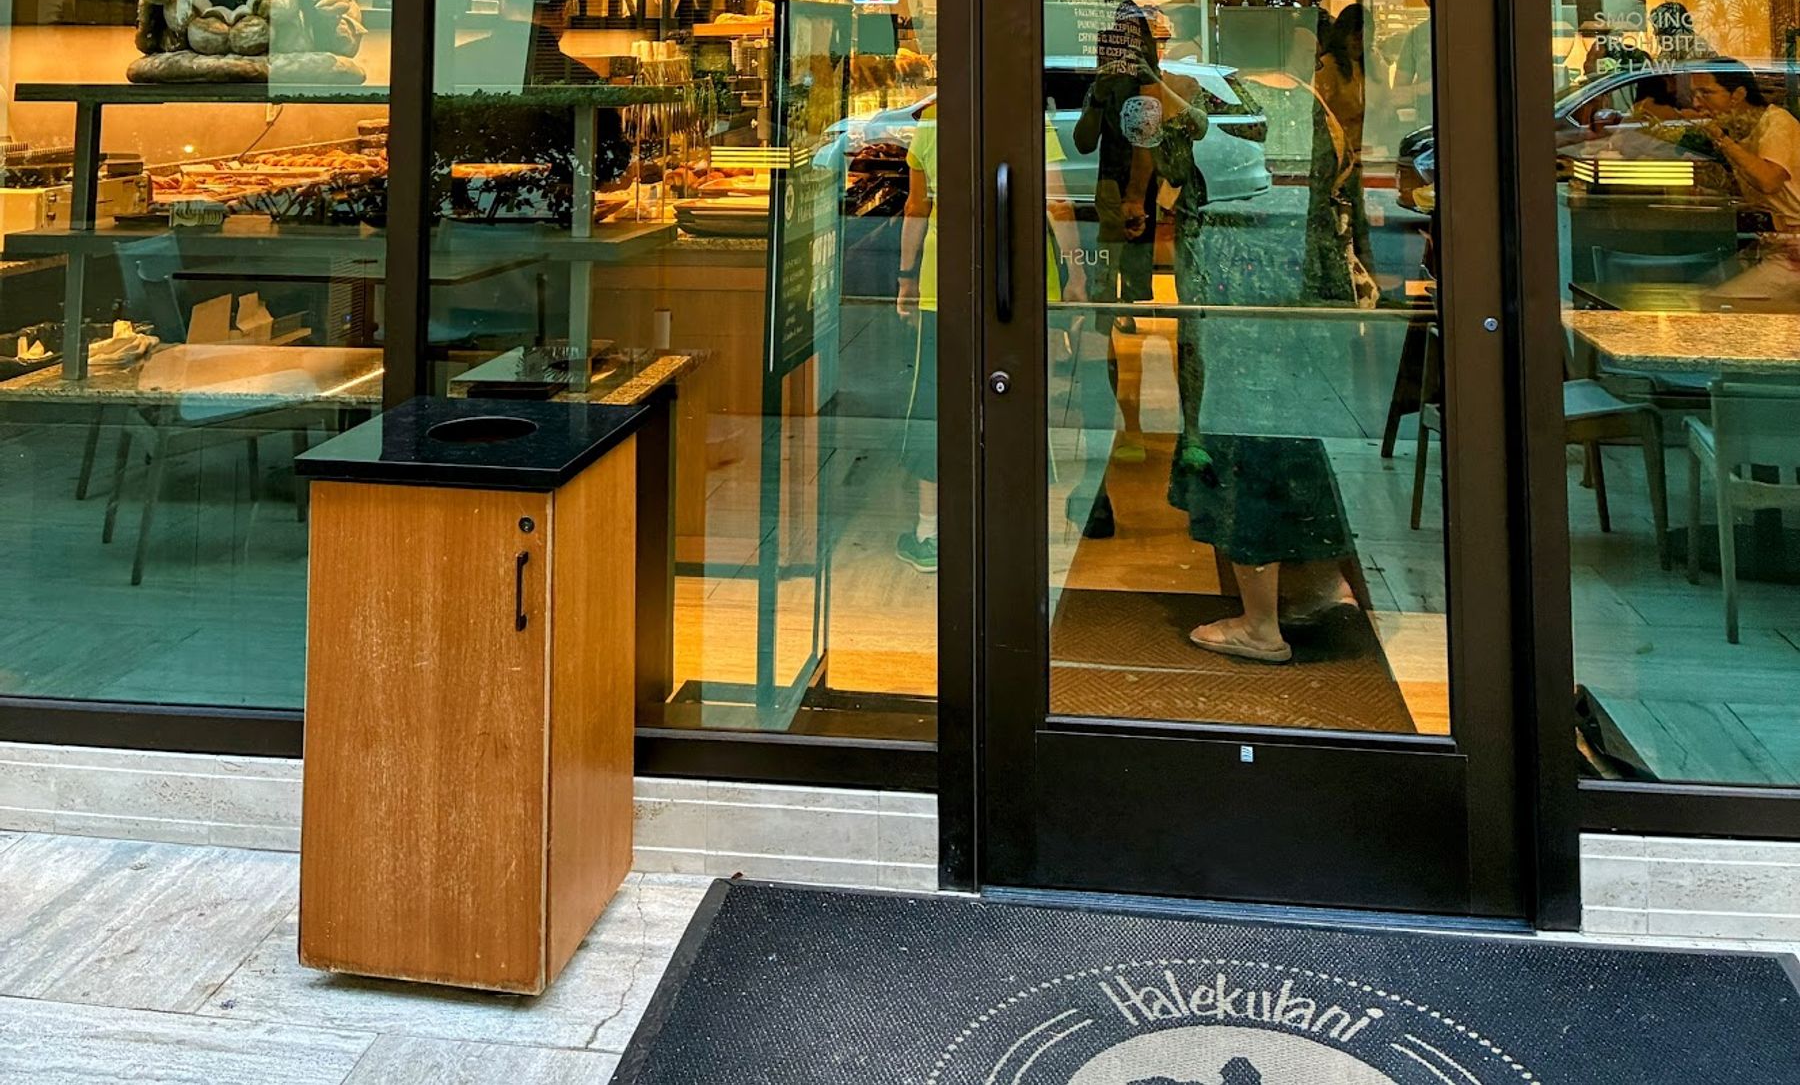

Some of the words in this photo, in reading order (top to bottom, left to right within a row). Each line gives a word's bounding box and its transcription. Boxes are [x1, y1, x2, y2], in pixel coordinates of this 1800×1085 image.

[1594, 11, 1695, 29] SMOKING
[1595, 35, 1718, 52] PROHIBITE
[1596, 58, 1622, 75] BY
[1628, 58, 1676, 75] LAW
[1100, 970, 1384, 1042] Halekulani
